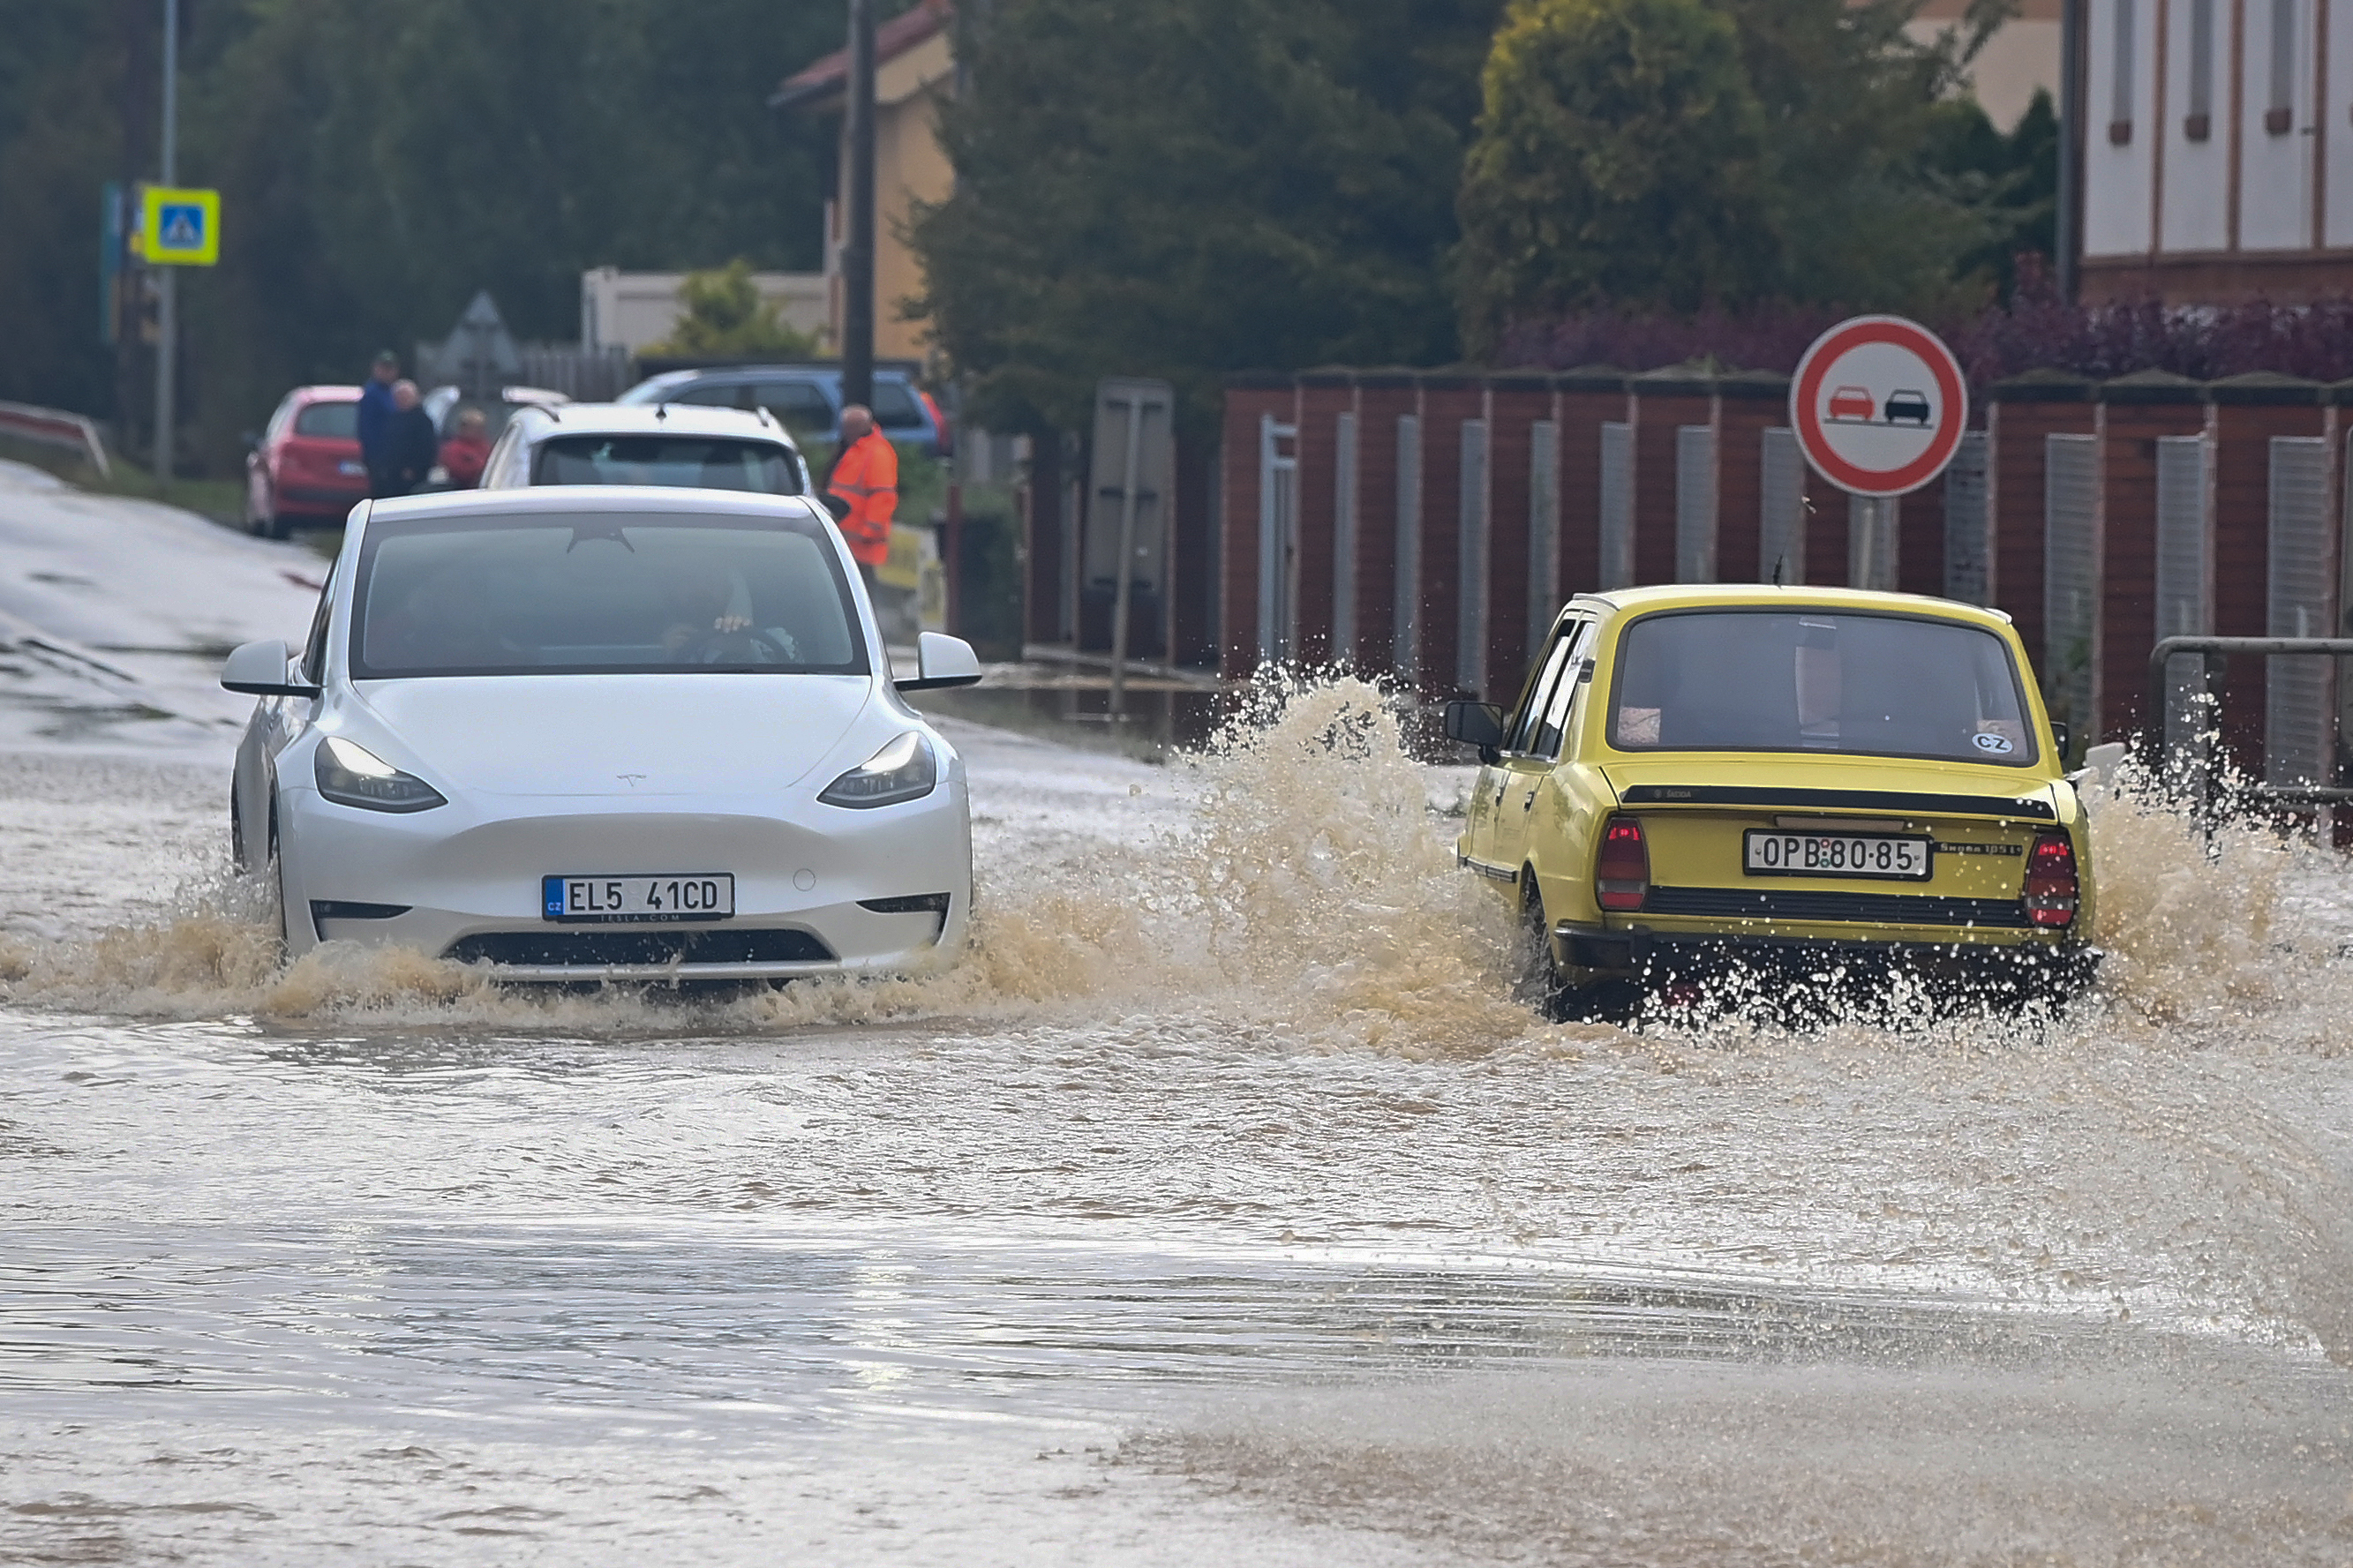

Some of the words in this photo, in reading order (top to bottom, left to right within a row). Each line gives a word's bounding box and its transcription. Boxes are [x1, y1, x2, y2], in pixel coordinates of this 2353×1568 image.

[1977, 735, 2008, 750] CZ
[569, 882, 622, 912] EL5
[646, 881, 718, 910] 41CD
[547, 902, 561, 912] CZ
